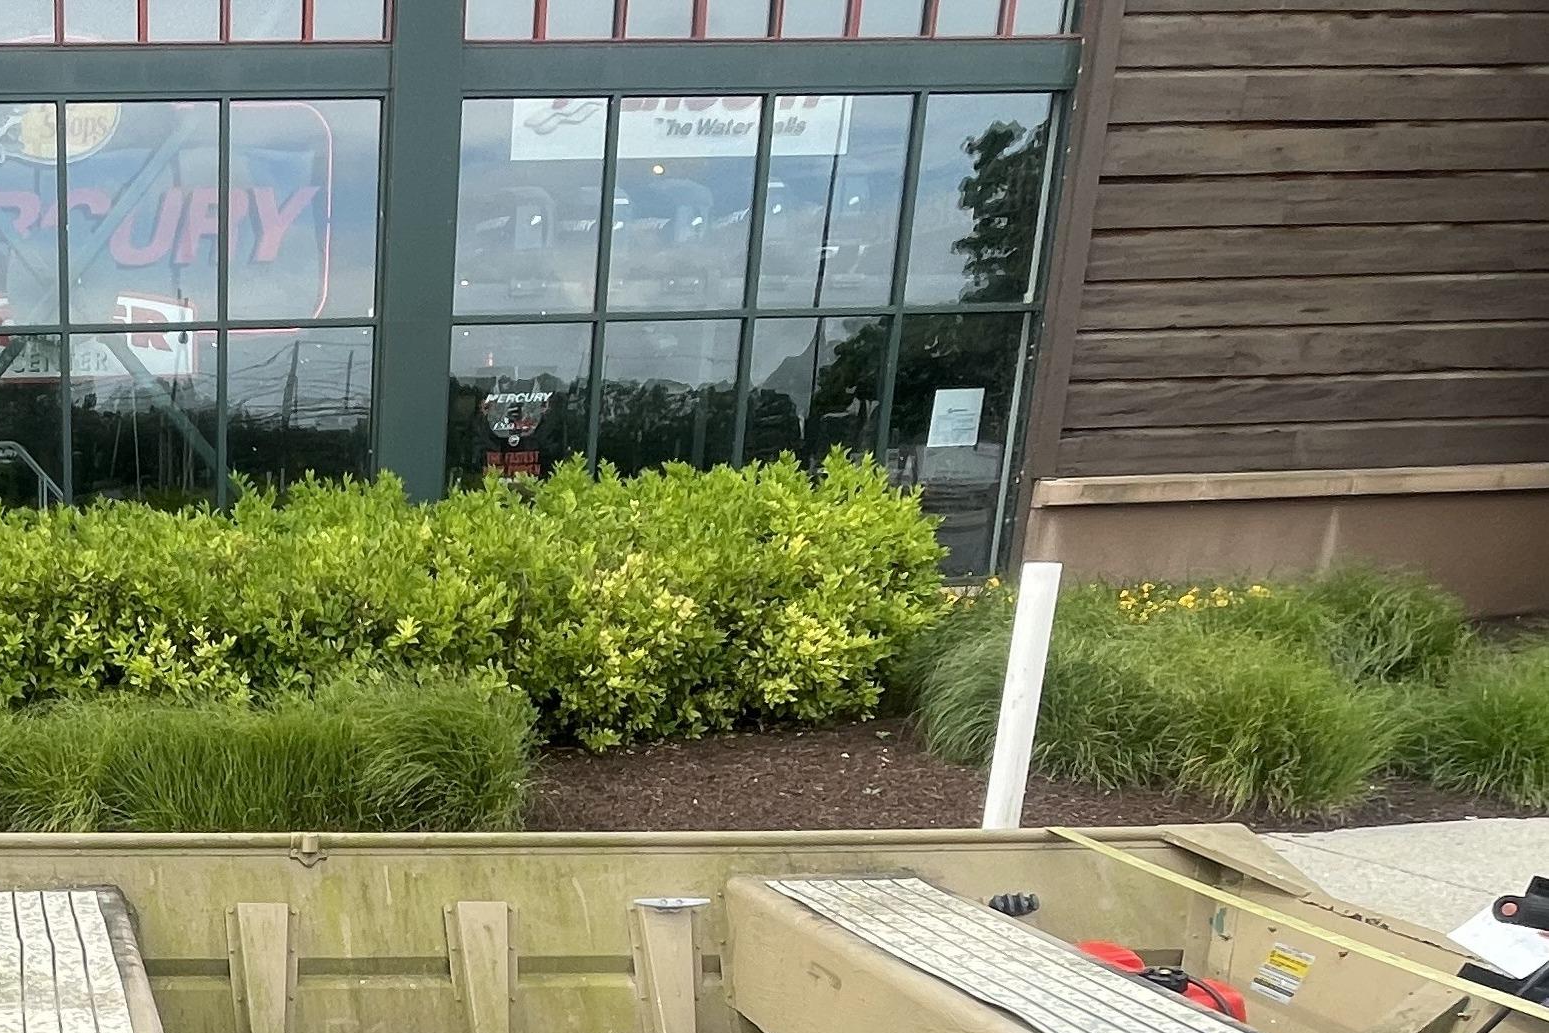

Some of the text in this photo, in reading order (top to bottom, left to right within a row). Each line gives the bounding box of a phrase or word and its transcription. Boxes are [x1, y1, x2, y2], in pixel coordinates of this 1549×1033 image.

[40, 106, 108, 145] Sops
[695, 114, 753, 138] Water
[484, 392, 553, 404] MERCURY
